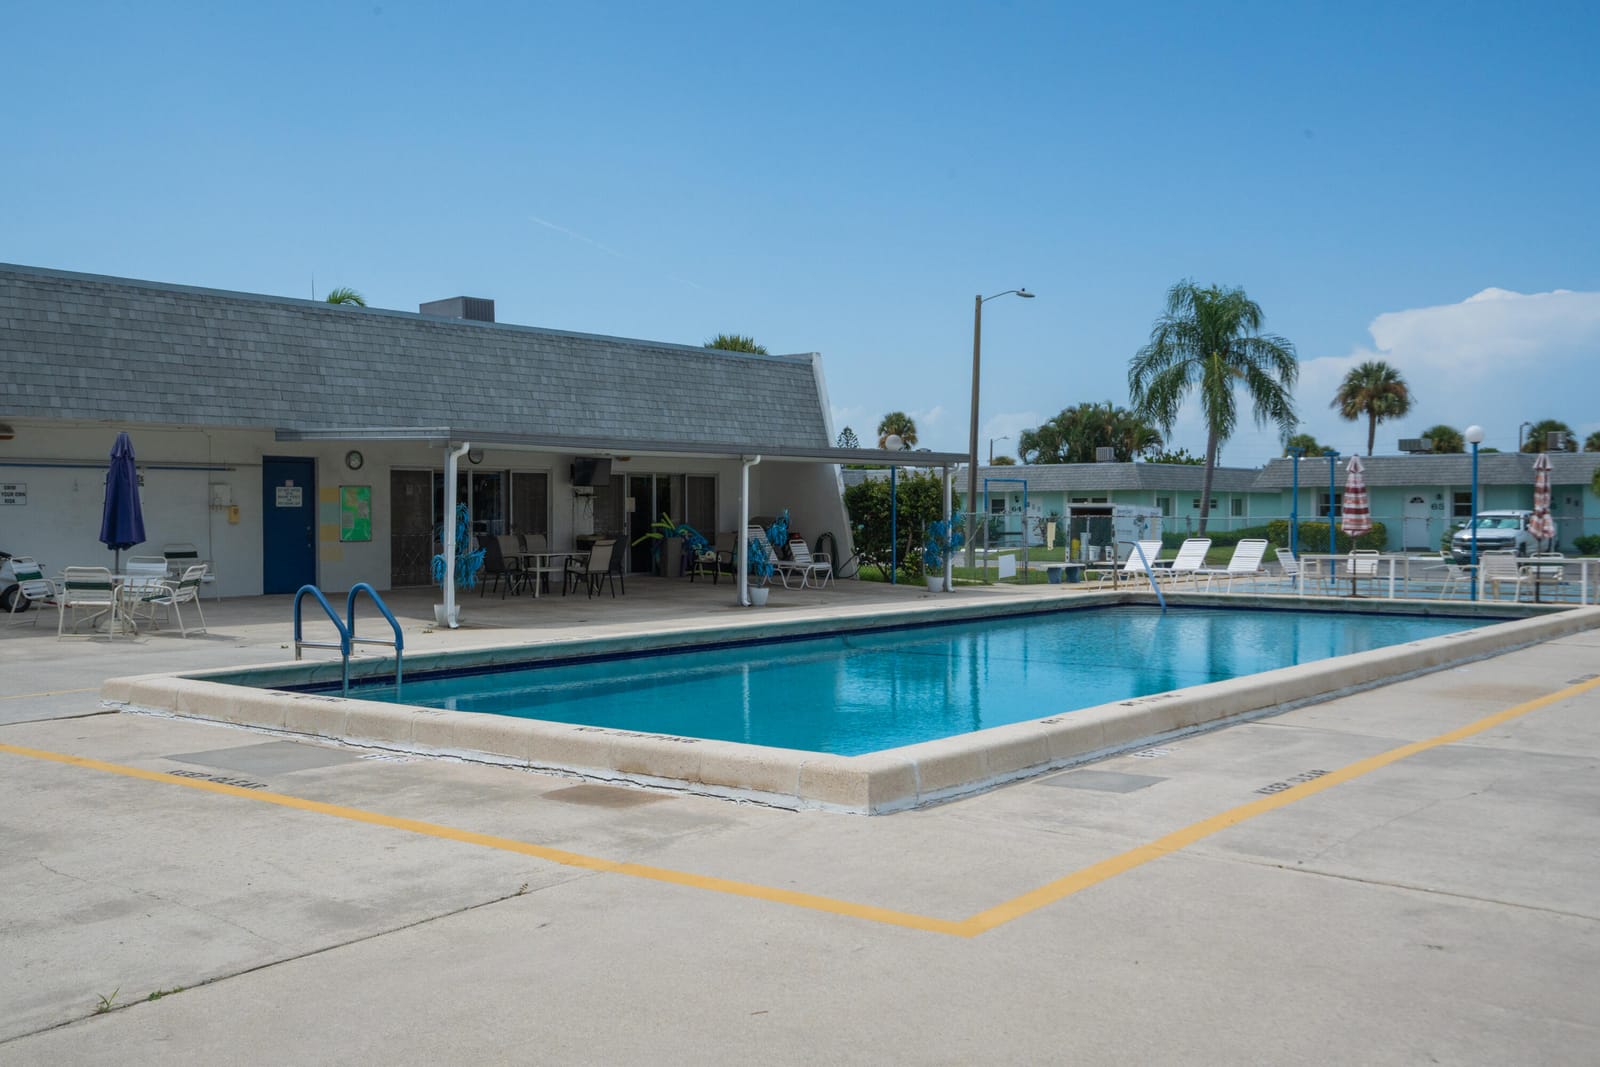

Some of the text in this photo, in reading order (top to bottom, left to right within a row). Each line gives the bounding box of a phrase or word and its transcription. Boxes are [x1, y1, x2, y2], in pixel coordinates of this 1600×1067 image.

[165, 769, 269, 790] KEEP CLEAR
[1251, 769, 1335, 795] KEEP CLEAR
